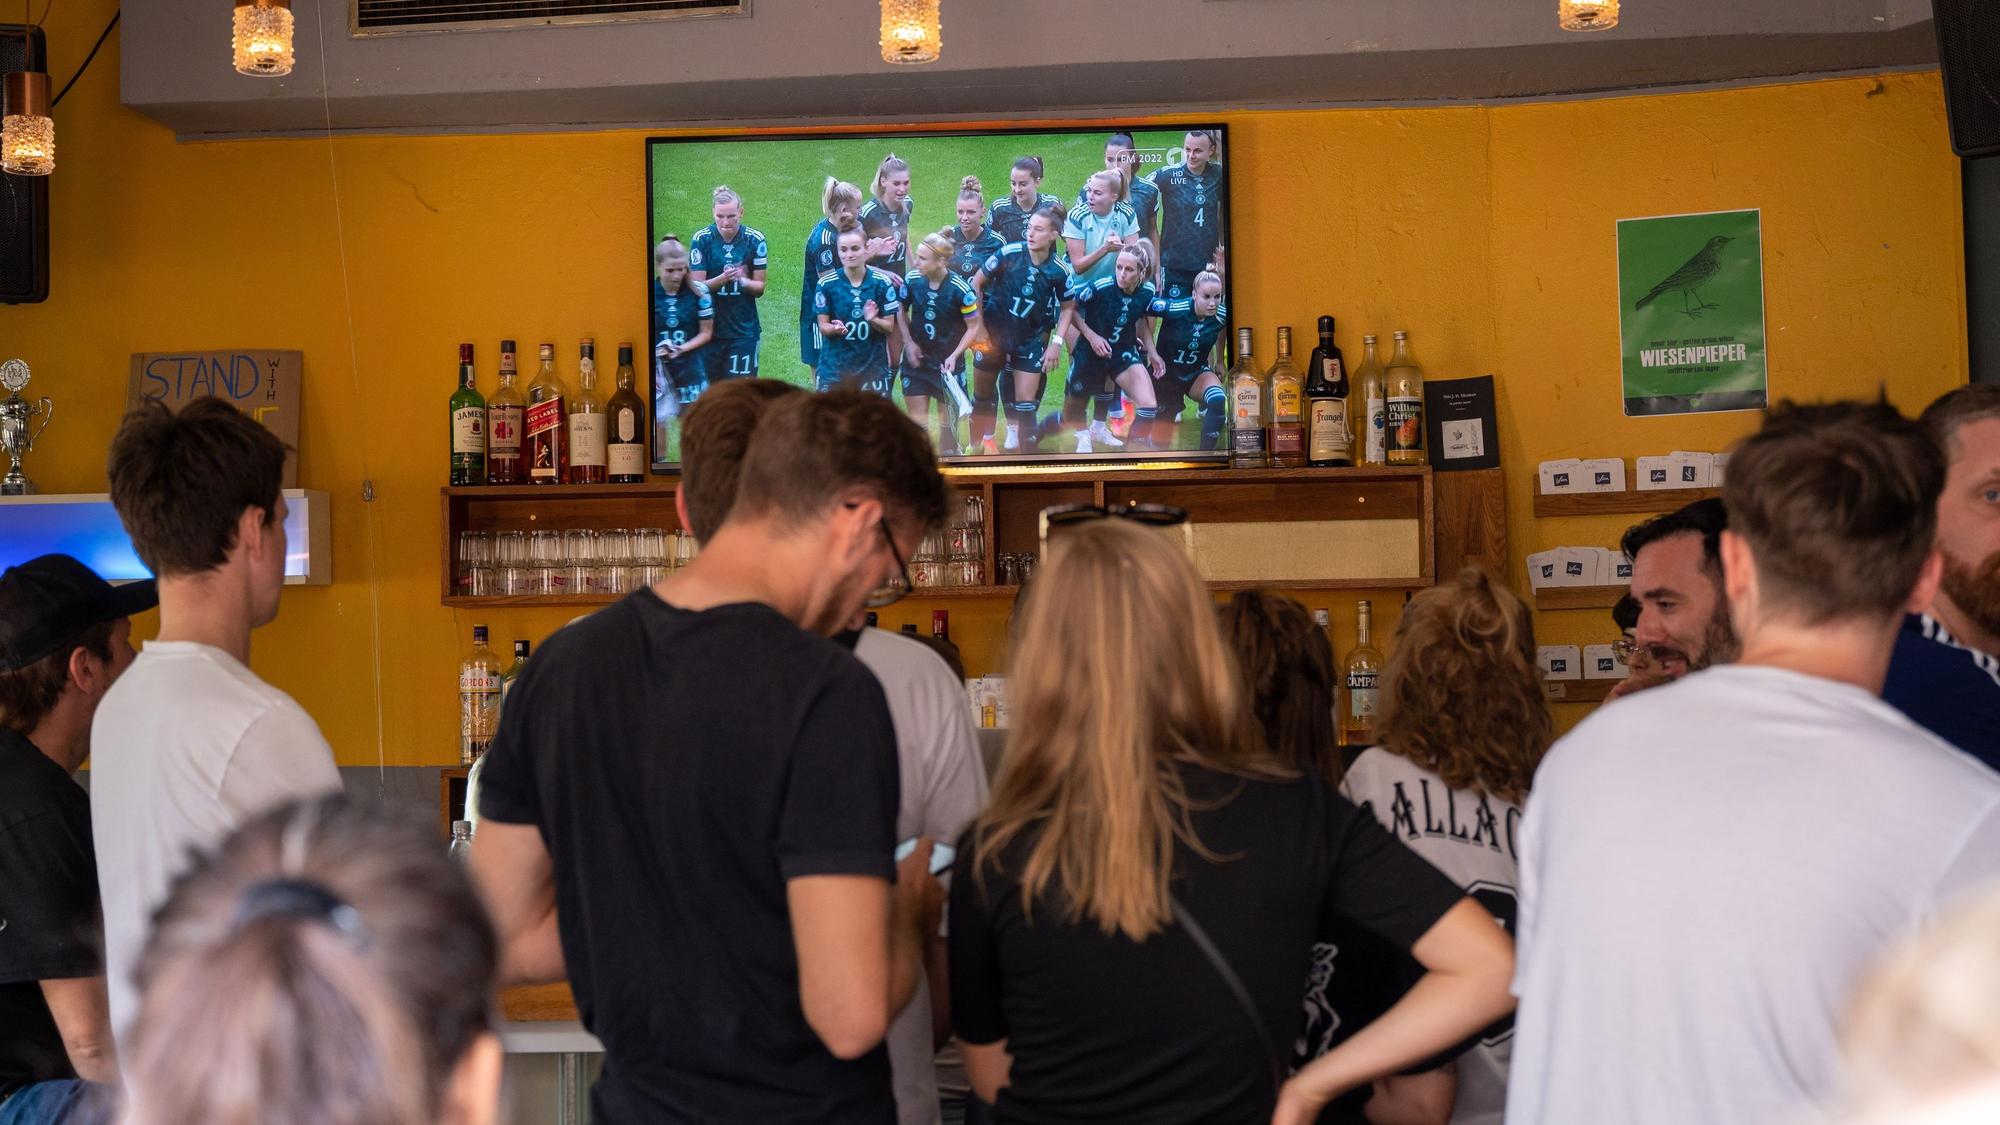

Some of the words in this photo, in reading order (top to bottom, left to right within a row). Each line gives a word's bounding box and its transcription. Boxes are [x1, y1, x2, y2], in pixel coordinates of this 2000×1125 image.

[1122, 154, 1136, 164] EM
[1139, 153, 1162, 163] 2022
[1194, 207, 1205, 227] 4
[1008, 296, 1036, 319] 17
[844, 320, 869, 340] 20
[924, 323, 937, 340] 9
[1108, 326, 1124, 343] 3
[729, 354, 751, 374] 11
[1173, 349, 1200, 365] 15
[1640, 343, 1747, 368] WIESENPIEPER
[145, 354, 259, 400] STAND
[266, 358, 280, 401] WITH
[539, 407, 559, 419] LABEL
